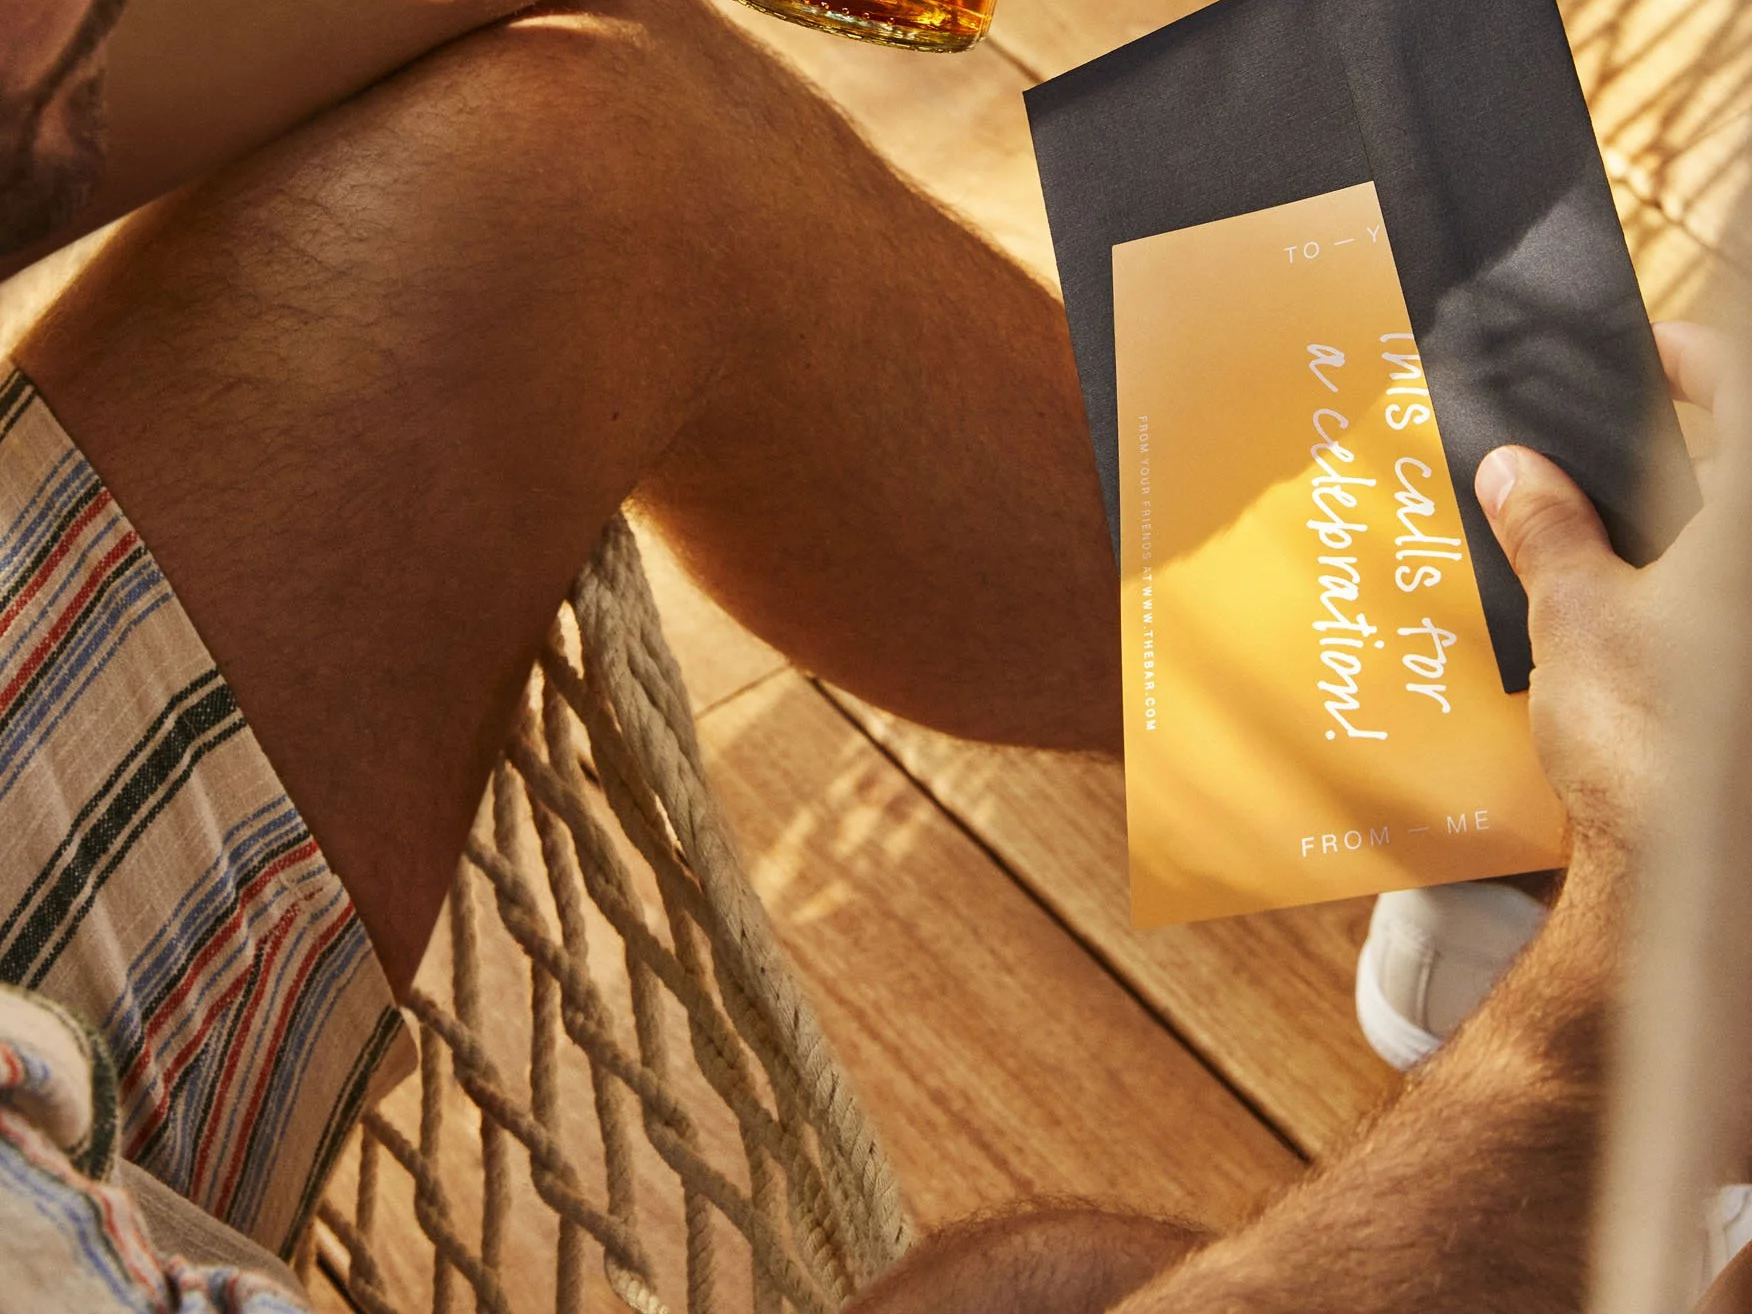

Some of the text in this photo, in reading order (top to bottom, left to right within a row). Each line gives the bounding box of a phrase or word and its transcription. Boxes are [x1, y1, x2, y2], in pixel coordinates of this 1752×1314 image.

[1283, 241, 1321, 265] TO
[1138, 415, 1156, 731] FROM YOUR FRIENDS AT WWW.THEBAR.COM
[1306, 343, 1388, 741] a celebration!
[1394, 456, 1462, 592] calls
[1397, 617, 1458, 714] for
[1301, 825, 1391, 859] FROM
[1446, 810, 1490, 834] ME
